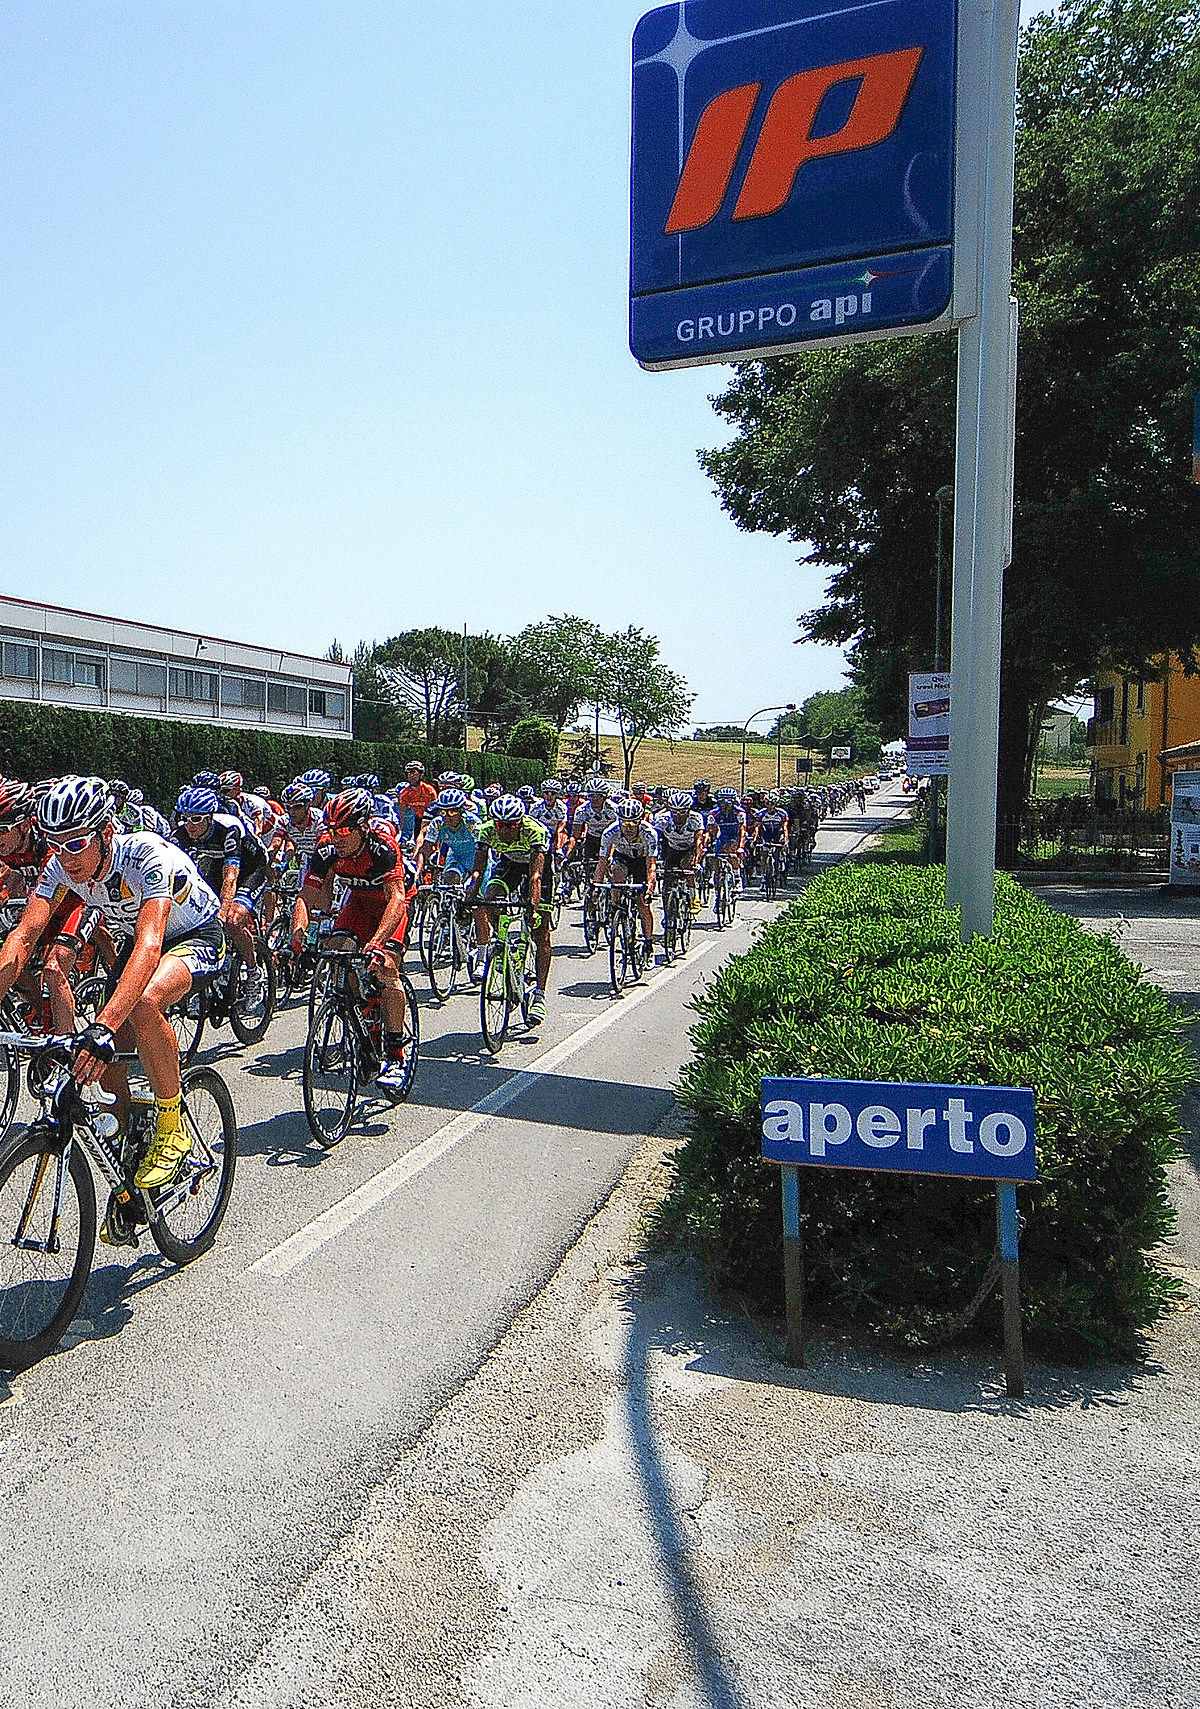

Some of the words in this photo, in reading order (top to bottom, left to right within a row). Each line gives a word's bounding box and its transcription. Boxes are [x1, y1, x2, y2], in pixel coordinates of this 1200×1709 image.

[665, 47, 923, 233] IP
[677, 303, 796, 342] GRUPPO
[809, 291, 872, 325] api
